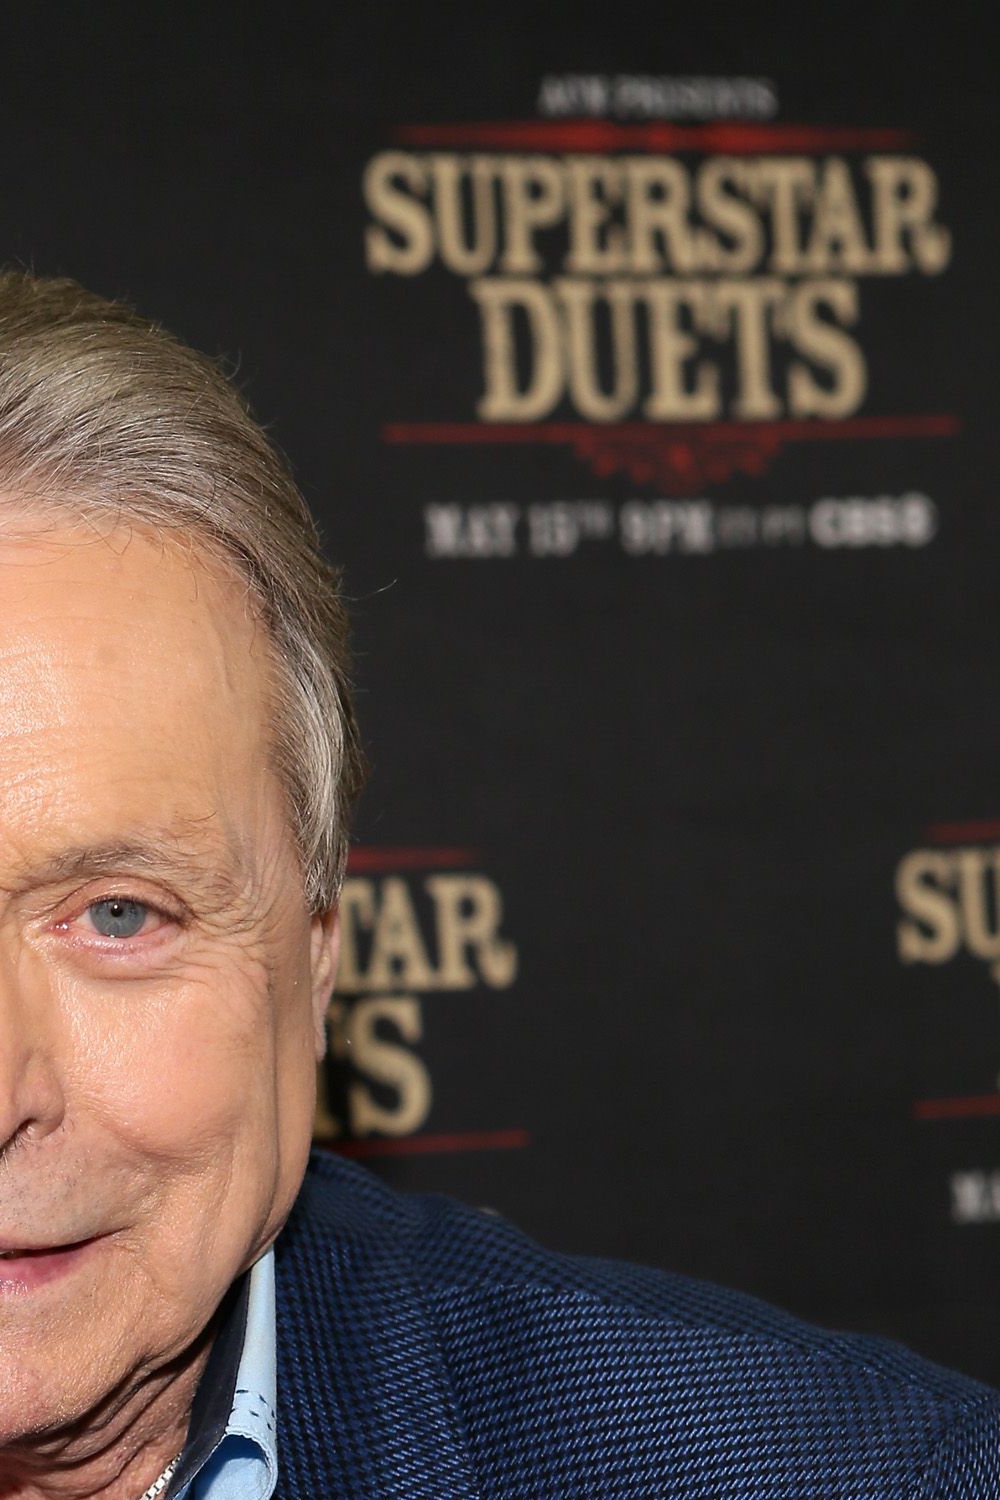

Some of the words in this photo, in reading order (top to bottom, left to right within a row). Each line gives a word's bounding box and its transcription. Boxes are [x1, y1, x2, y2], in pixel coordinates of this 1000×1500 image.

[361, 150, 952, 276] SUPERSTAR
[467, 275, 868, 424] DUETS
[424, 503, 518, 558] MAY
